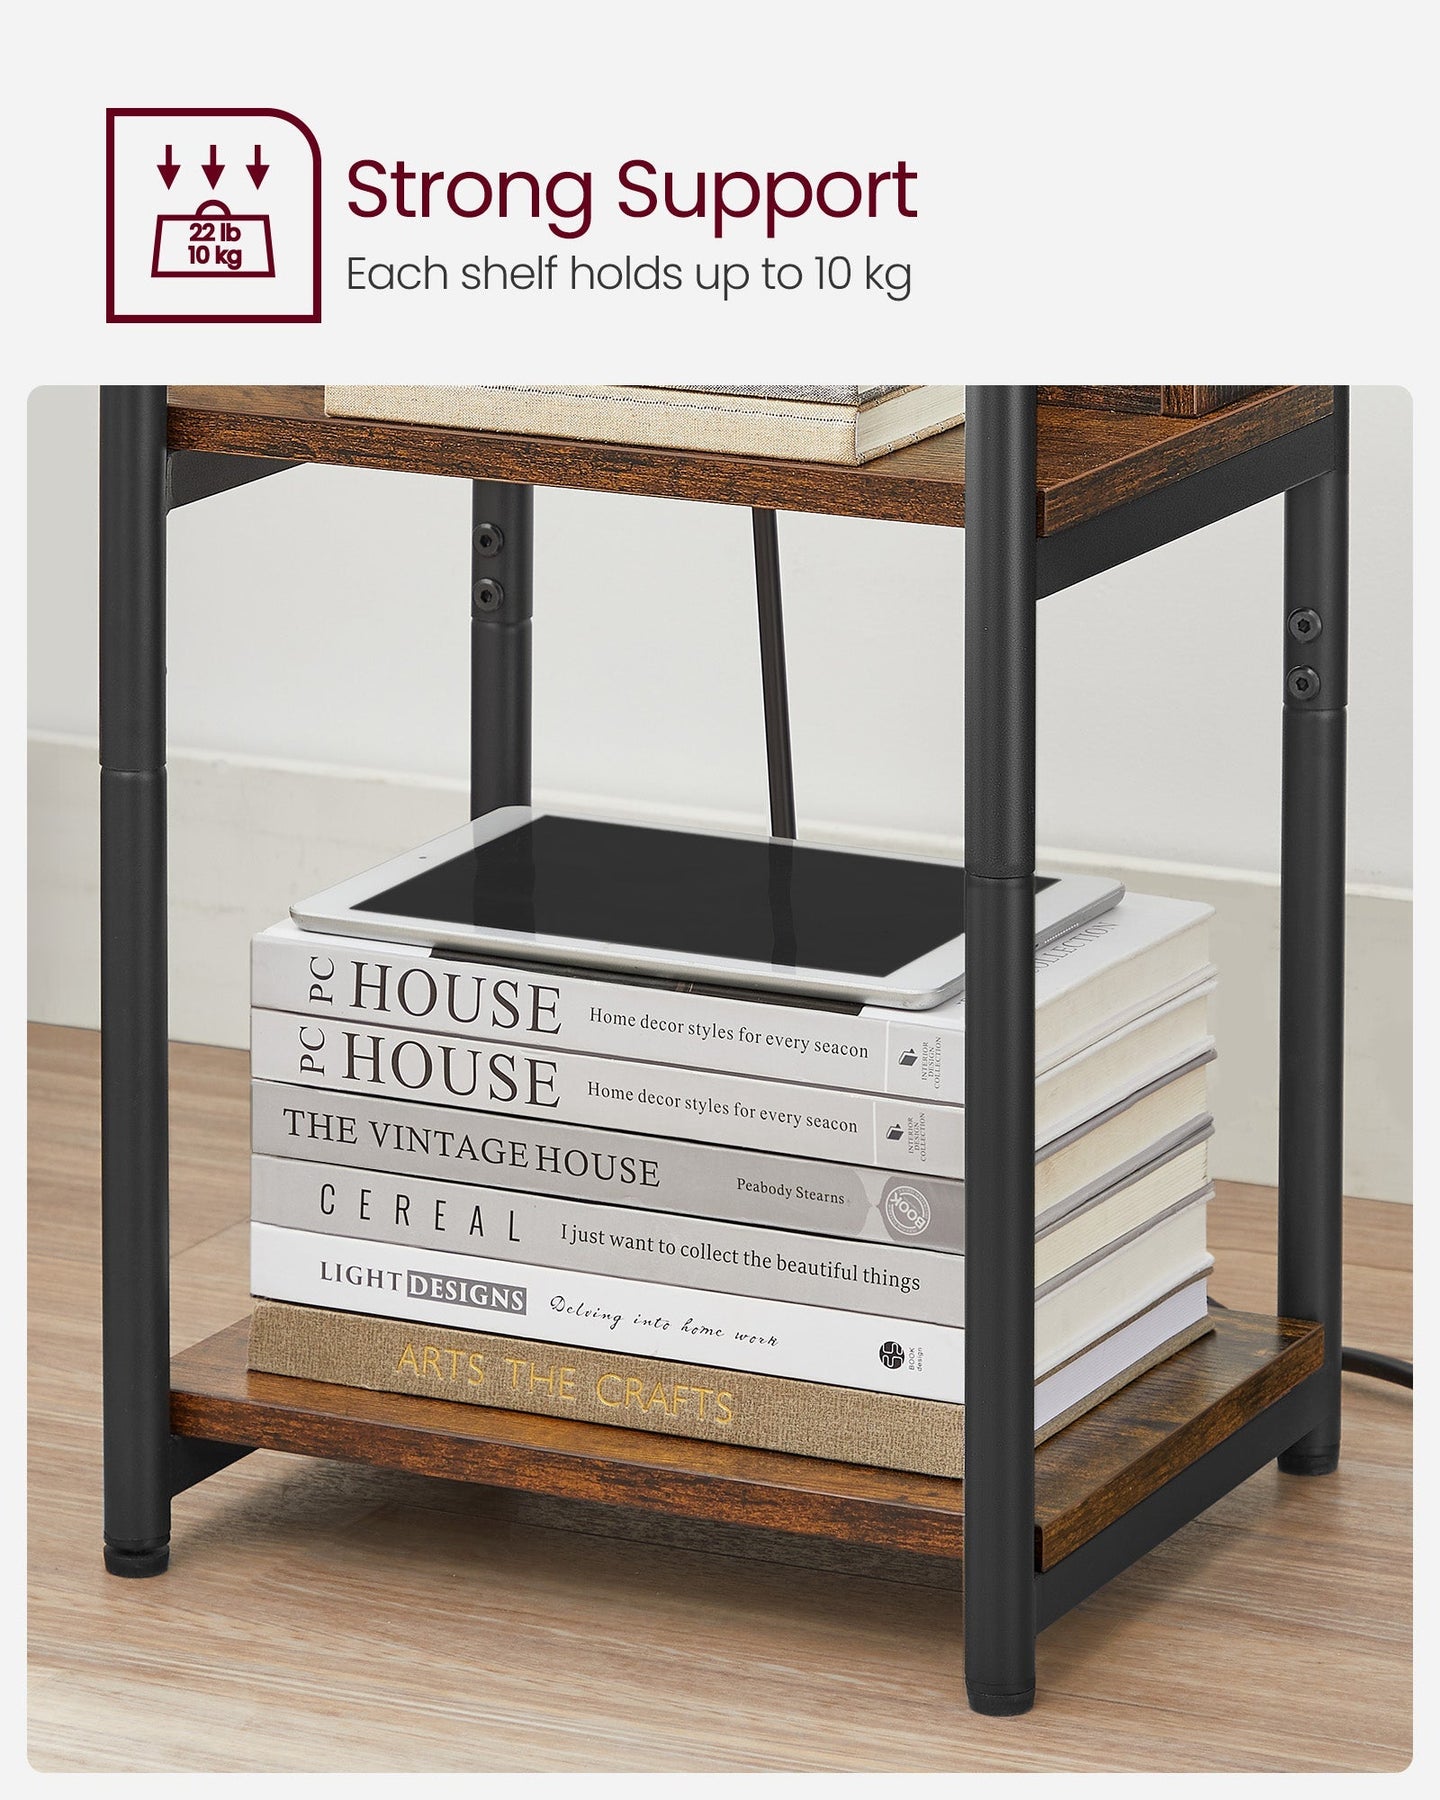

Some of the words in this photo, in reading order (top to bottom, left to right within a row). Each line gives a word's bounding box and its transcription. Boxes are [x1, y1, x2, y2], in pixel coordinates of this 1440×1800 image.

[1035, 922, 1118, 974] OLLECTION
[309, 957, 334, 1005] PC
[350, 960, 562, 1035] HOUSE
[300, 1026, 325, 1076] PC
[591, 1007, 635, 1026] Home
[641, 1014, 684, 1033] decor
[689, 1023, 733, 1040] styles
[739, 1027, 761, 1043] for
[766, 1035, 809, 1053] every
[815, 1041, 867, 1058] seacon
[341, 1031, 561, 1108] HOUSE
[589, 1082, 633, 1101] Home
[638, 1089, 681, 1107] decor
[685, 1098, 729, 1115] styles
[735, 1102, 755, 1118] for
[760, 1110, 801, 1128] every
[807, 1117, 857, 1133] seacon
[283, 1108, 357, 1144] THE
[368, 1120, 529, 1168] VINTAGE
[535, 1145, 660, 1187] HOUSE
[737, 1178, 792, 1199] Peabody
[796, 1187, 844, 1204] Stearns
[890, 1191, 926, 1229] BOOK
[561, 1223, 568, 1240] I
[570, 1225, 605, 1245] just
[610, 1235, 654, 1252] want
[659, 1240, 675, 1255] to
[681, 1243, 738, 1264] collect
[744, 1250, 771, 1268] the
[777, 1254, 857, 1281] beautiful
[864, 1267, 919, 1293] things
[321, 1262, 402, 1291] LIGHT
[408, 1273, 525, 1311] DESIGNS
[550, 1296, 621, 1330] Delving
[634, 1314, 669, 1330] into
[681, 1318, 721, 1336] home
[735, 1332, 777, 1346] work
[396, 1341, 486, 1388] ARTS
[504, 1356, 577, 1402] THE
[595, 1372, 734, 1427] CRAFTS
[908, 1347, 916, 1371] BOOK
